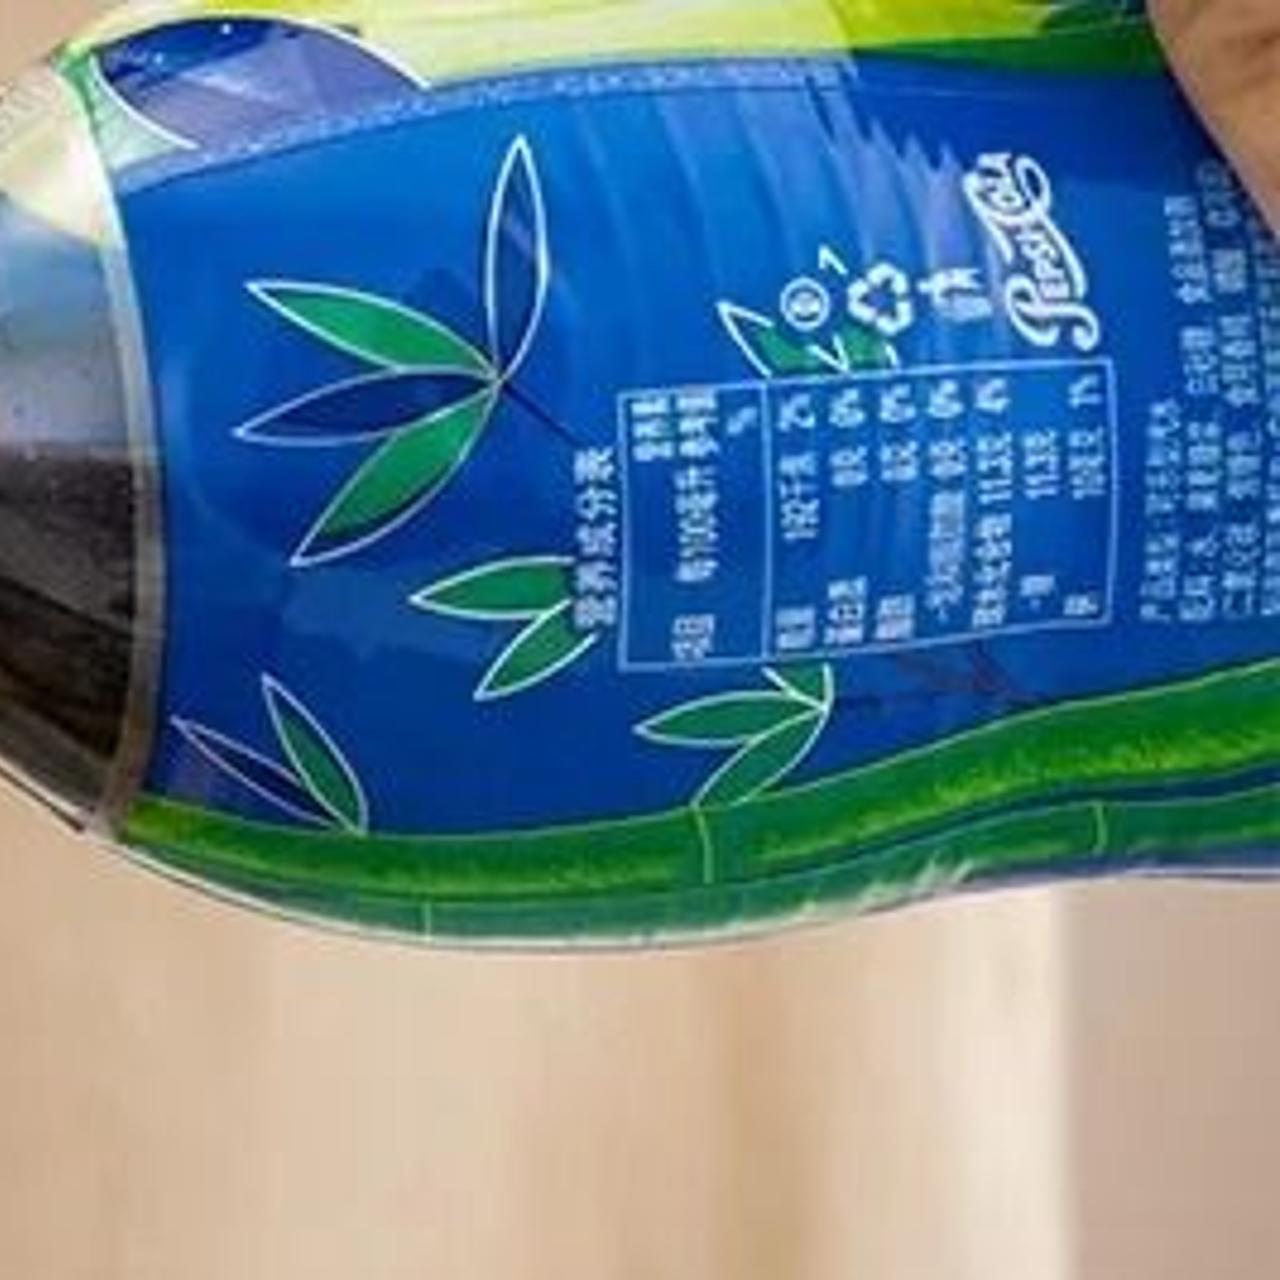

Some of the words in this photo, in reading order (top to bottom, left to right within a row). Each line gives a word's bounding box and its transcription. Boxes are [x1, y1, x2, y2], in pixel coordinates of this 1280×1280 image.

[573, 446, 618, 631] 营养成分表
